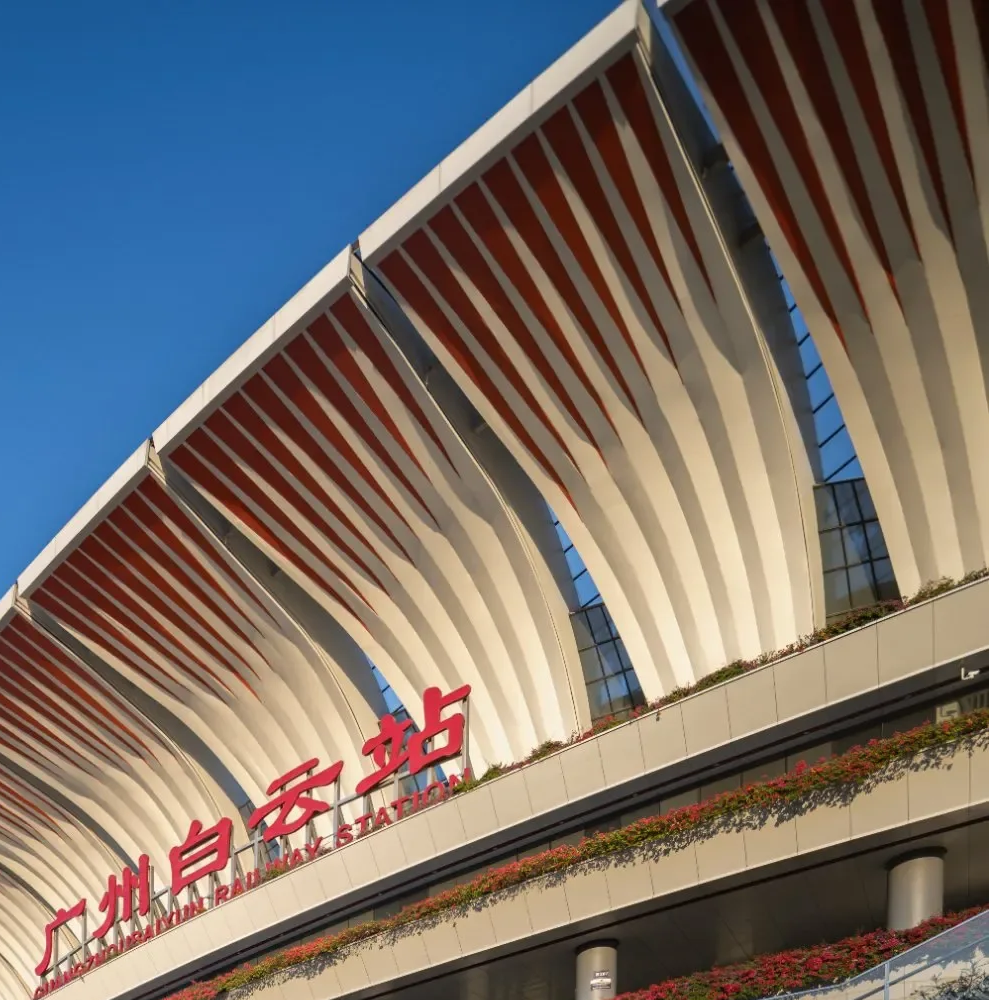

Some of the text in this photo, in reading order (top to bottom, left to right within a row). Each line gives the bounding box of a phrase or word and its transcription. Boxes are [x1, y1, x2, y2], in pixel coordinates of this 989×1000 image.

[34, 684, 472, 976] 广州白云站
[335, 767, 472, 849] STATION
